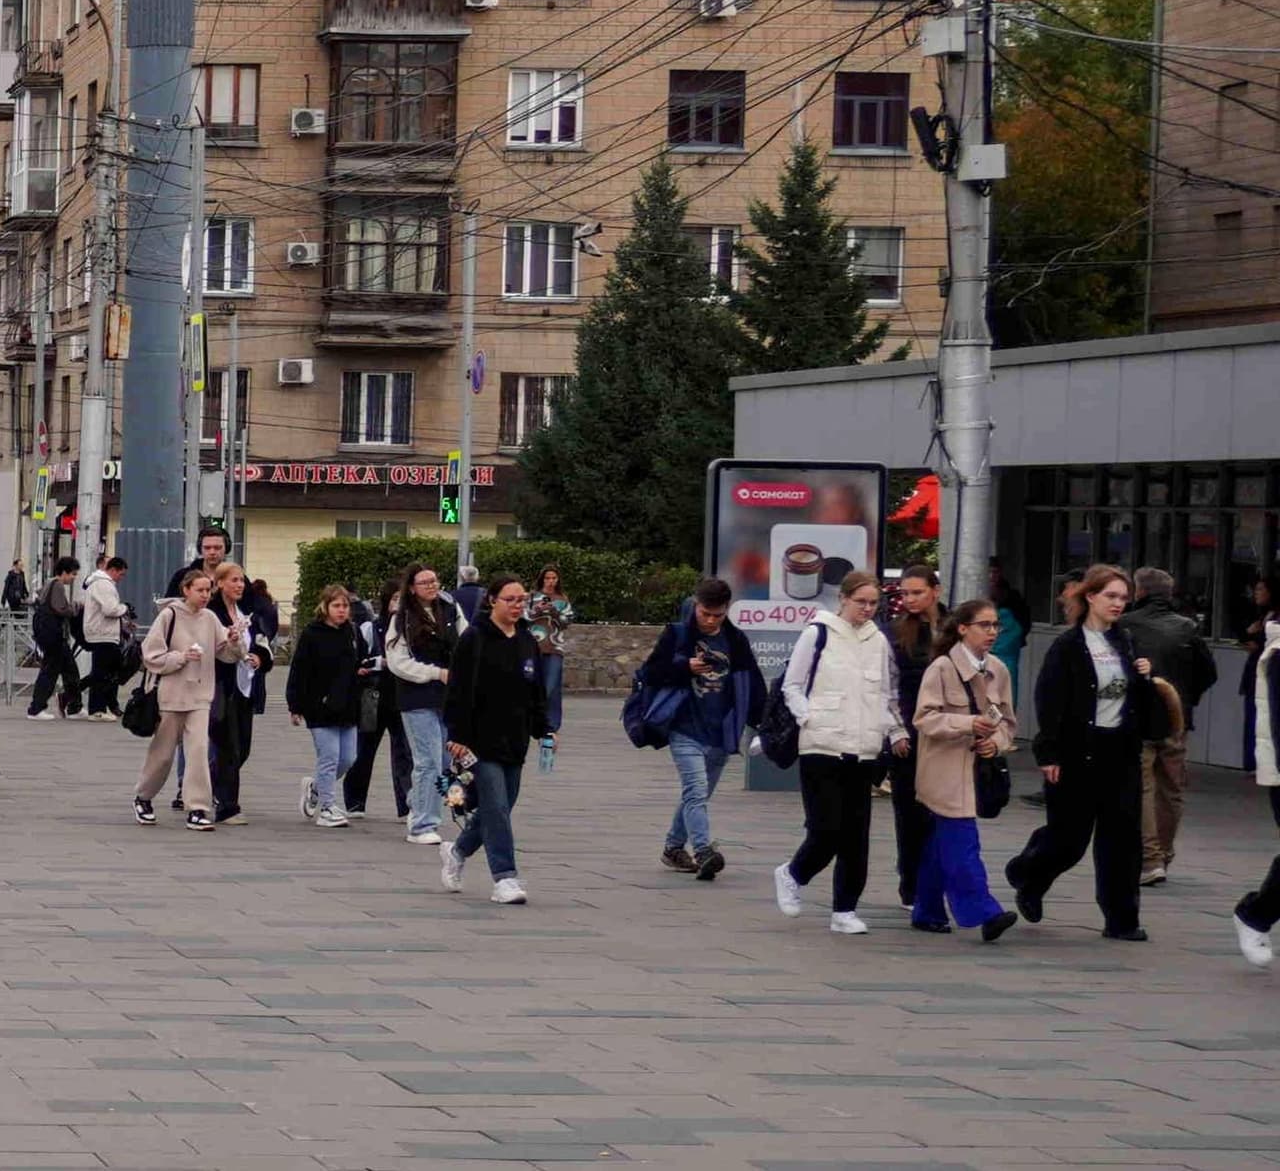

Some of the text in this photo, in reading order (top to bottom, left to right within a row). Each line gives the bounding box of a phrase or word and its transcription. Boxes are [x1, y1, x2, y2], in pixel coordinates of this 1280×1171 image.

[271, 464, 495, 486] АПТЕКА ОЗЕИ
[751, 491, 806, 500] самокат
[738, 610, 765, 624] до
